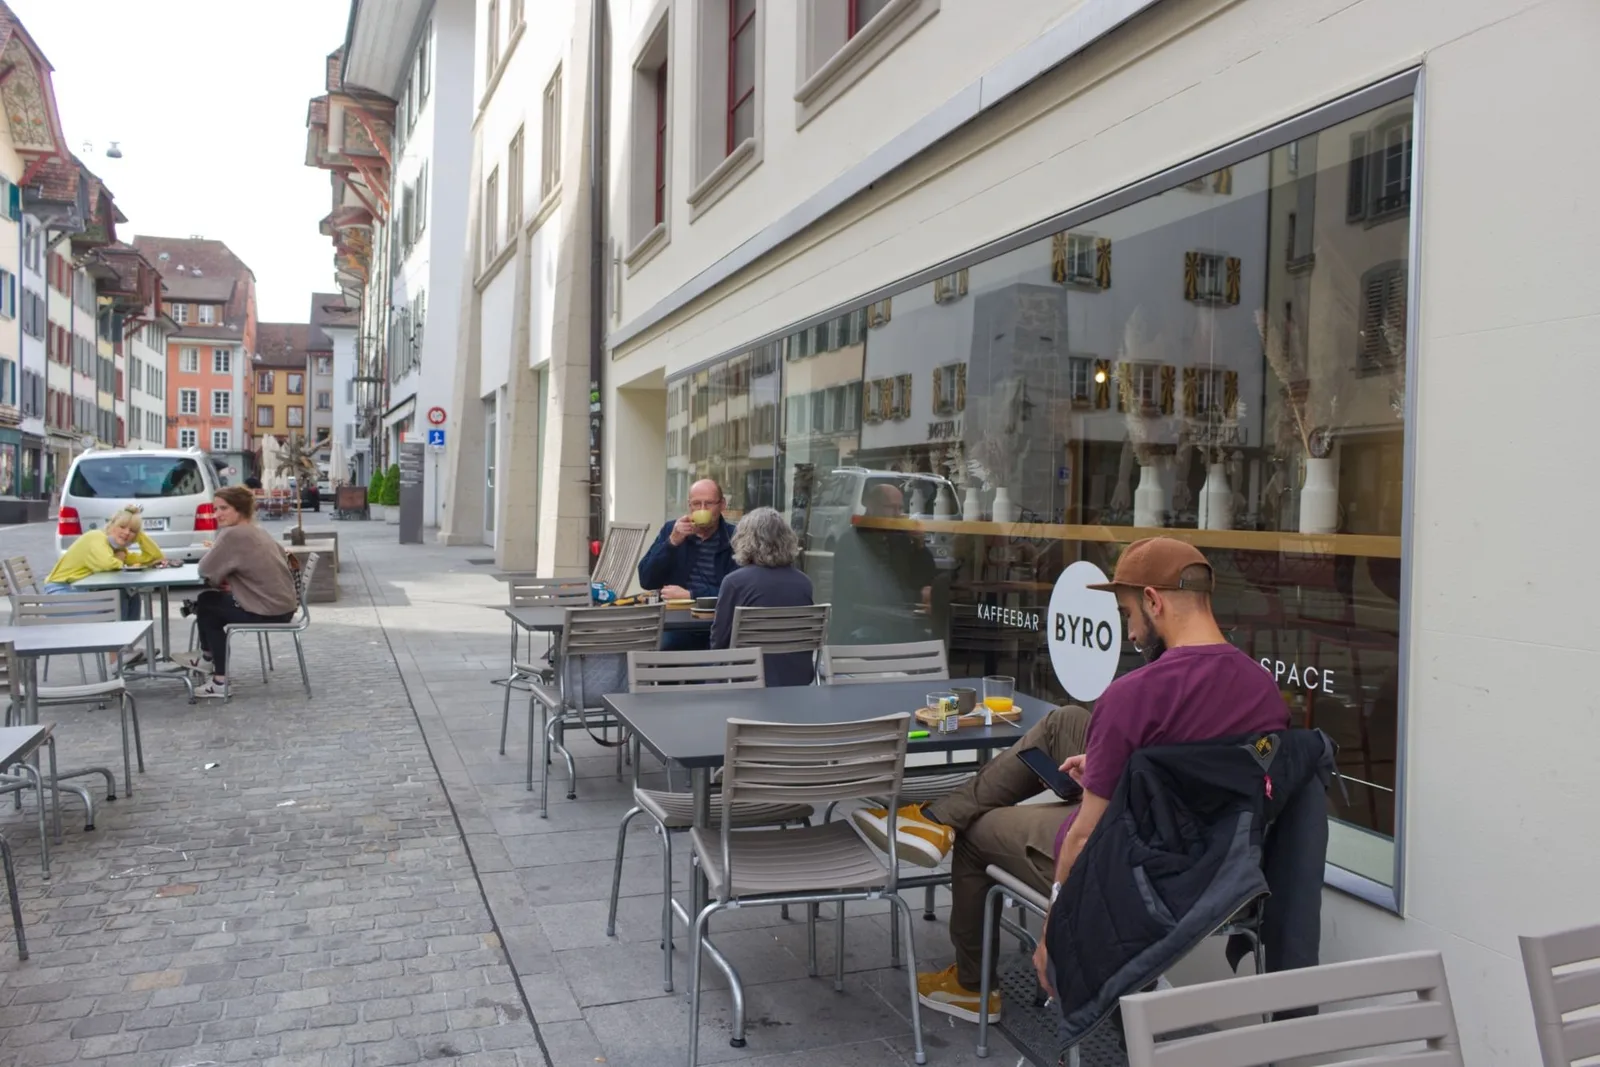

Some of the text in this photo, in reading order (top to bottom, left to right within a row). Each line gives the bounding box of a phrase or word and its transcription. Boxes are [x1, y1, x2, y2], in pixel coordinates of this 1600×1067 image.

[977, 603, 1040, 631] KAFFEEBAR
[1055, 612, 1112, 652] BYRO
[1260, 657, 1335, 693] SPACE
